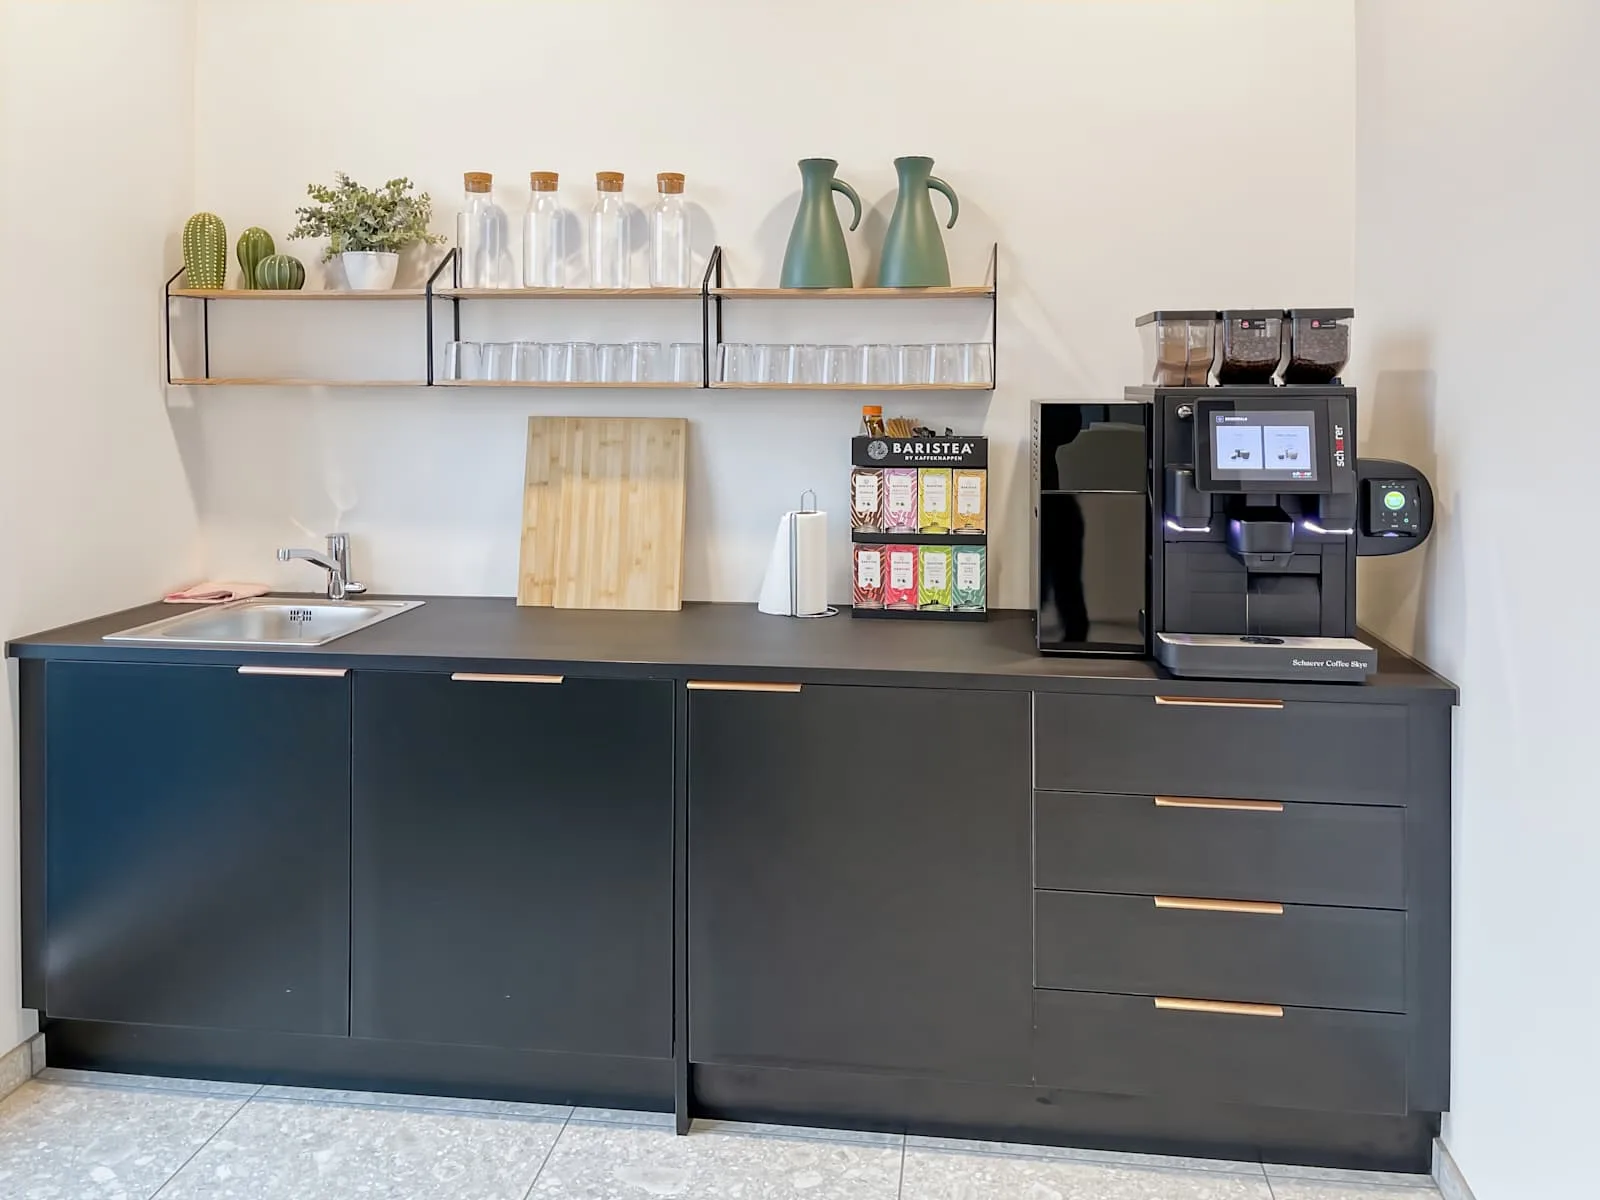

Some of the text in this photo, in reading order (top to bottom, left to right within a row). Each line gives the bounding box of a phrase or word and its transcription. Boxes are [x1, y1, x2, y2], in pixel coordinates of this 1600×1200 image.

[893, 442, 973, 454] BARISTEA
[1326, 659, 1350, 668] Coffee
[1350, 660, 1368, 669] Skye
